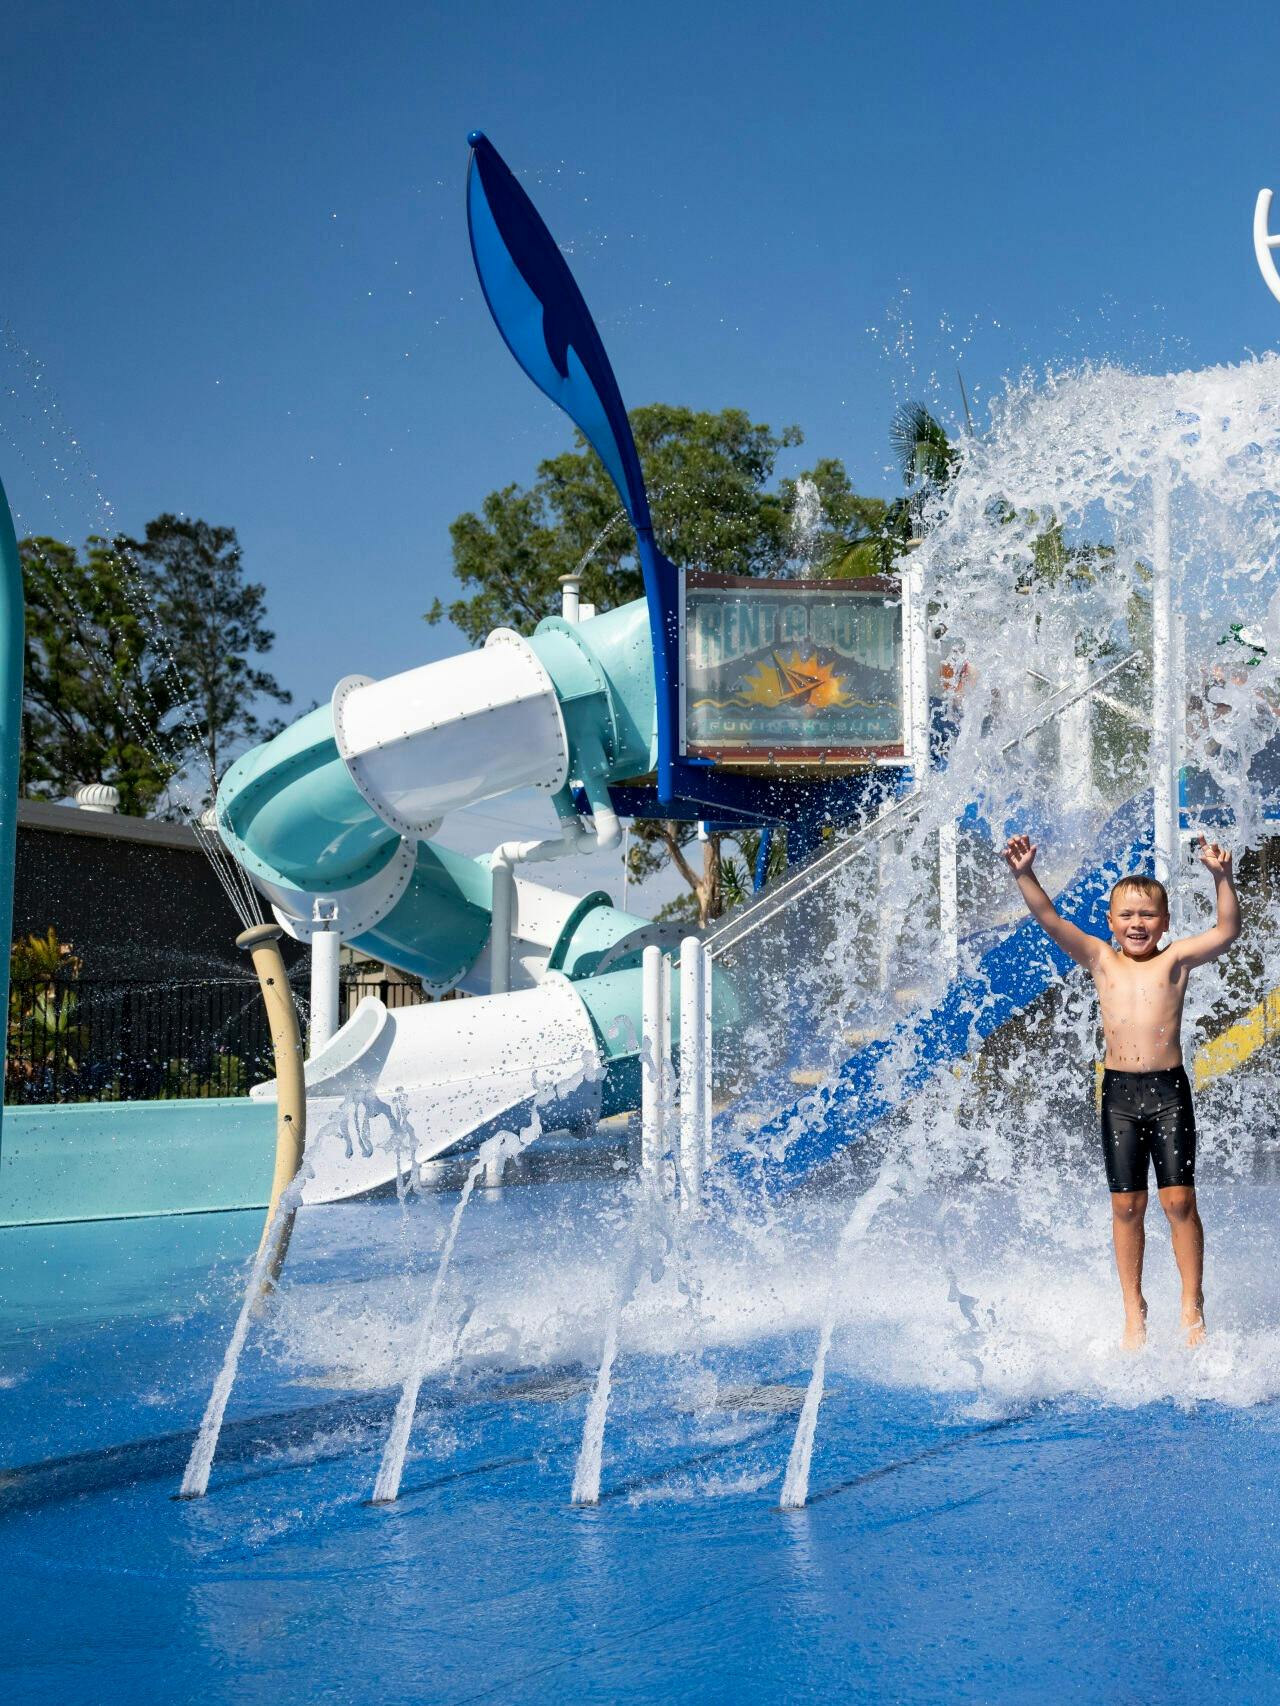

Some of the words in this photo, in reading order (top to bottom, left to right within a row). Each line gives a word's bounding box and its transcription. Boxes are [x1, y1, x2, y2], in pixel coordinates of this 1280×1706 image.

[696, 603, 779, 670] RENT
[780, 604, 808, 643] A
[710, 721, 753, 731] FUN
[836, 721, 880, 731] SUN
